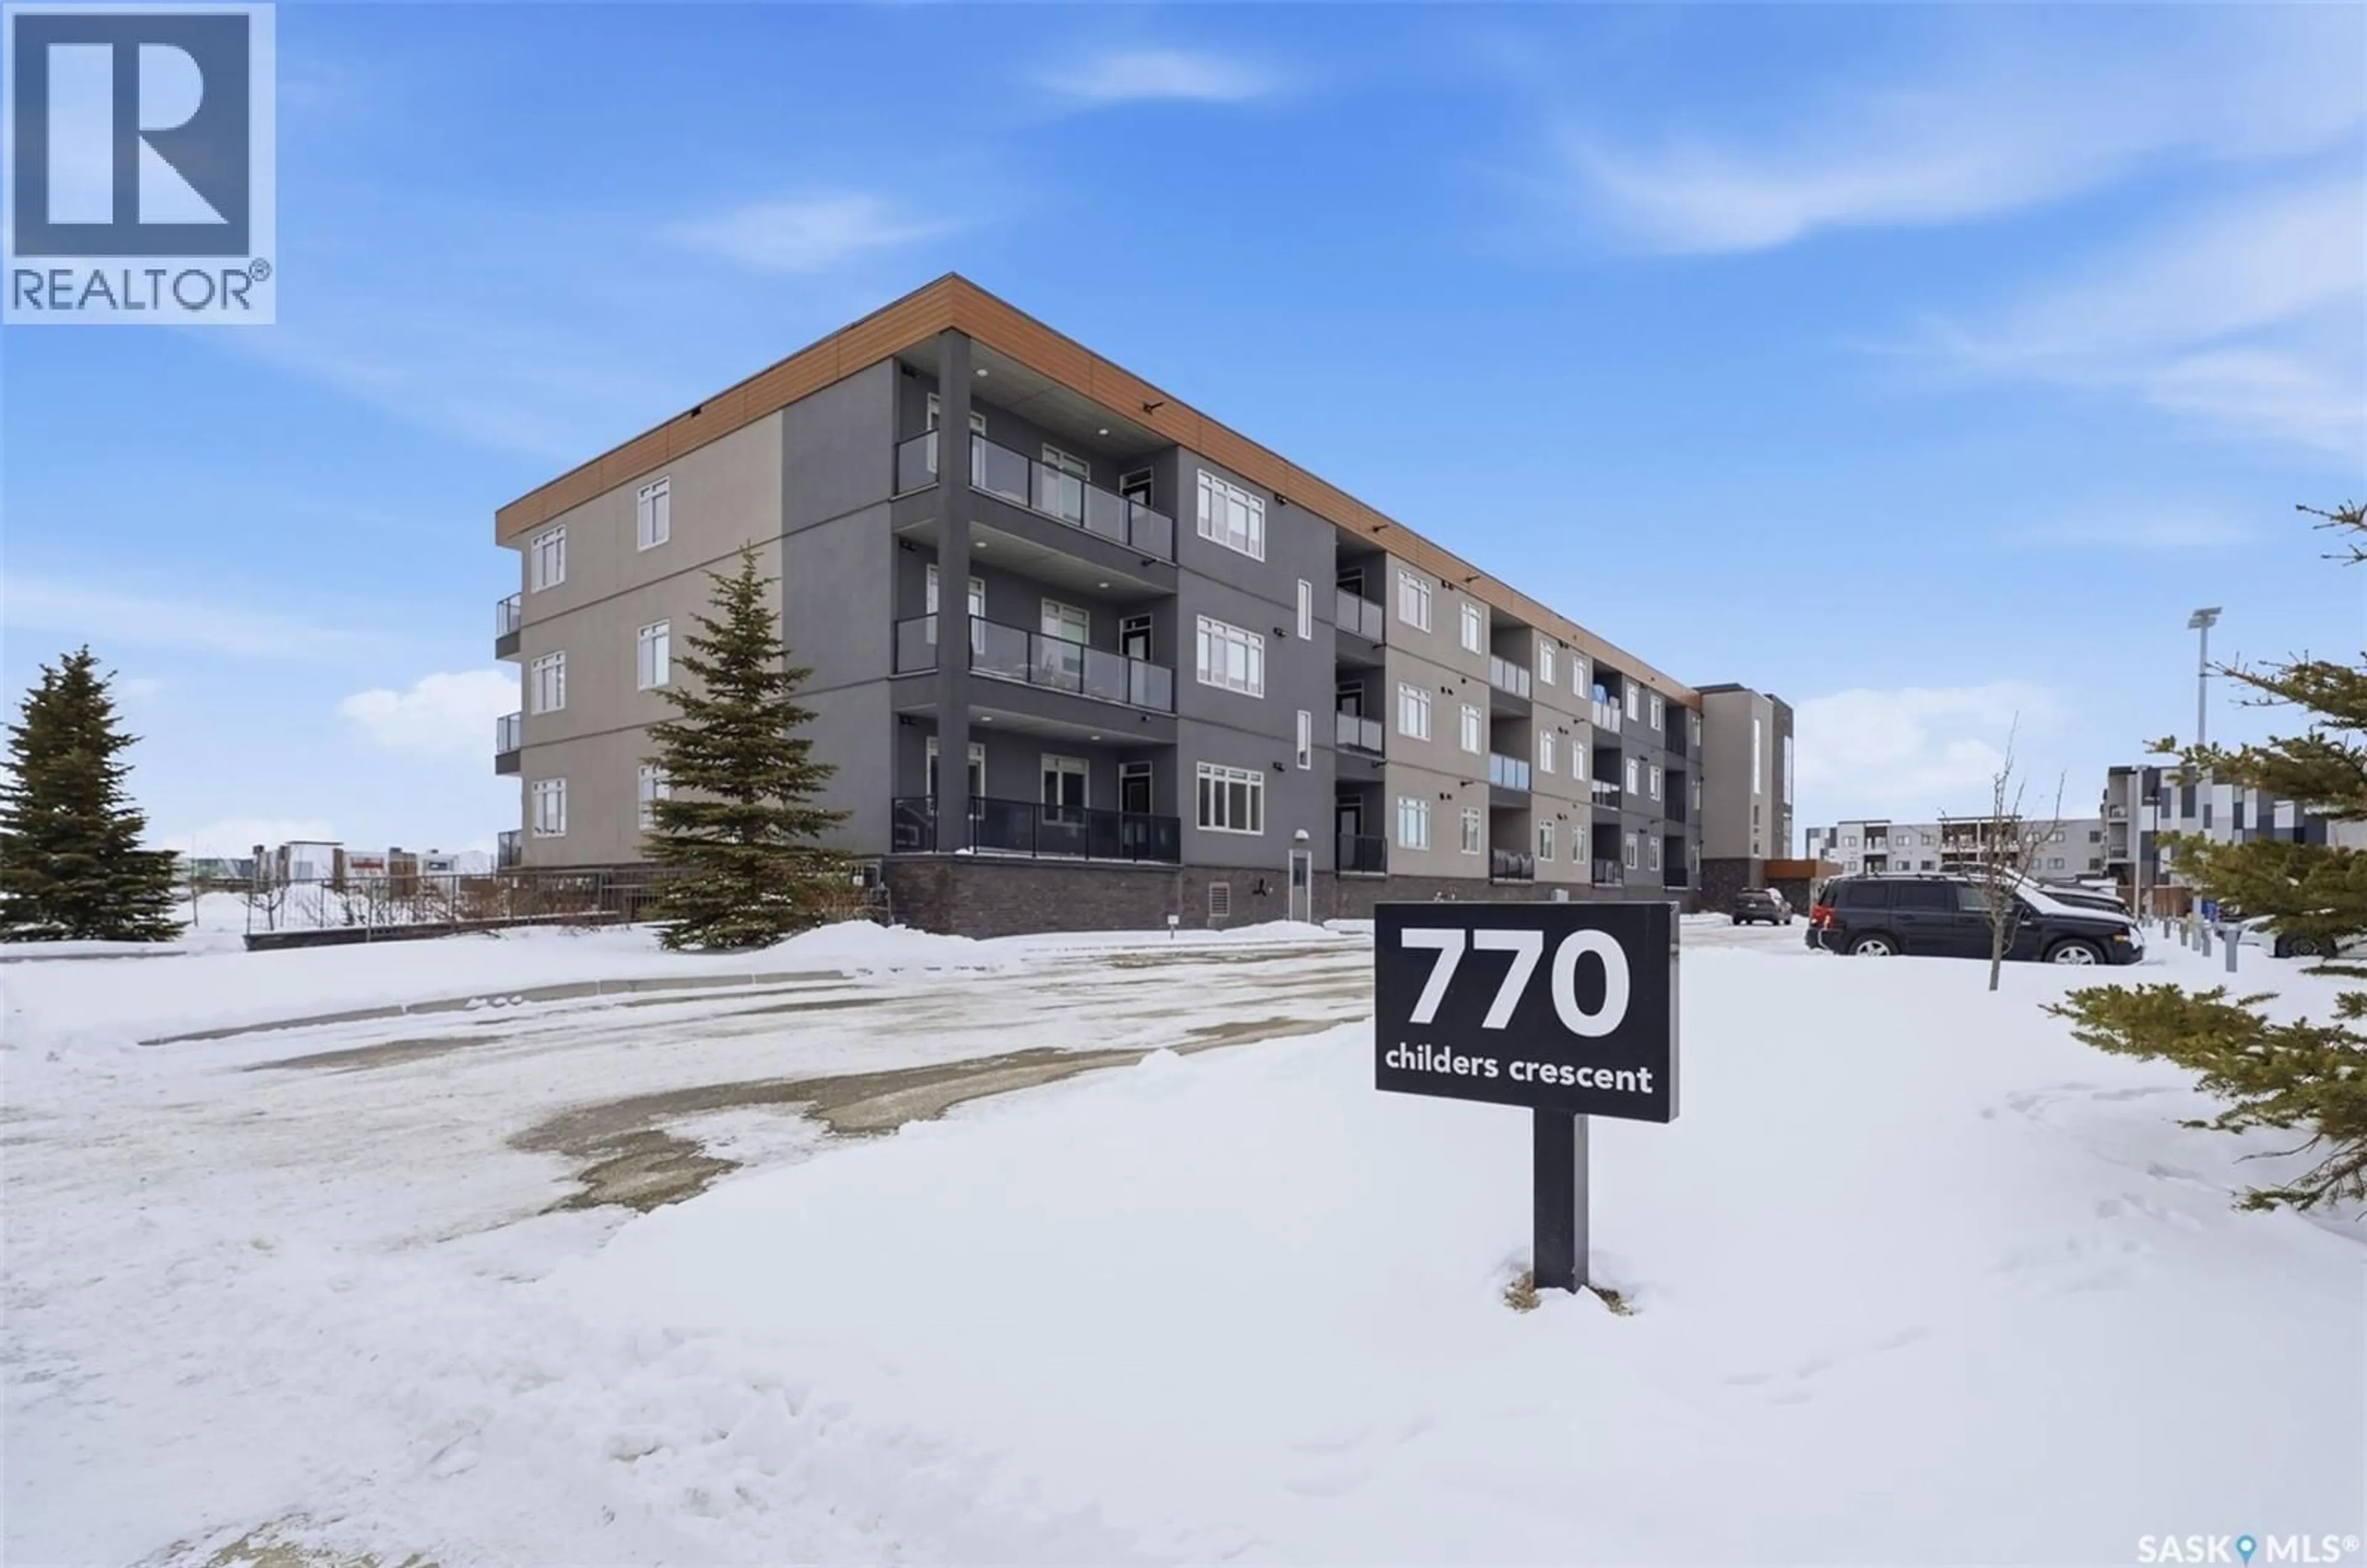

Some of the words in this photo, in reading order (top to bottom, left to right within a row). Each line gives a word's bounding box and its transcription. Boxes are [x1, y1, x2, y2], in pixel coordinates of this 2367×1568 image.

[1401, 928, 1629, 1037] 770
[1385, 1042, 1498, 1077] childers
[1509, 1061, 1653, 1093] crescent
